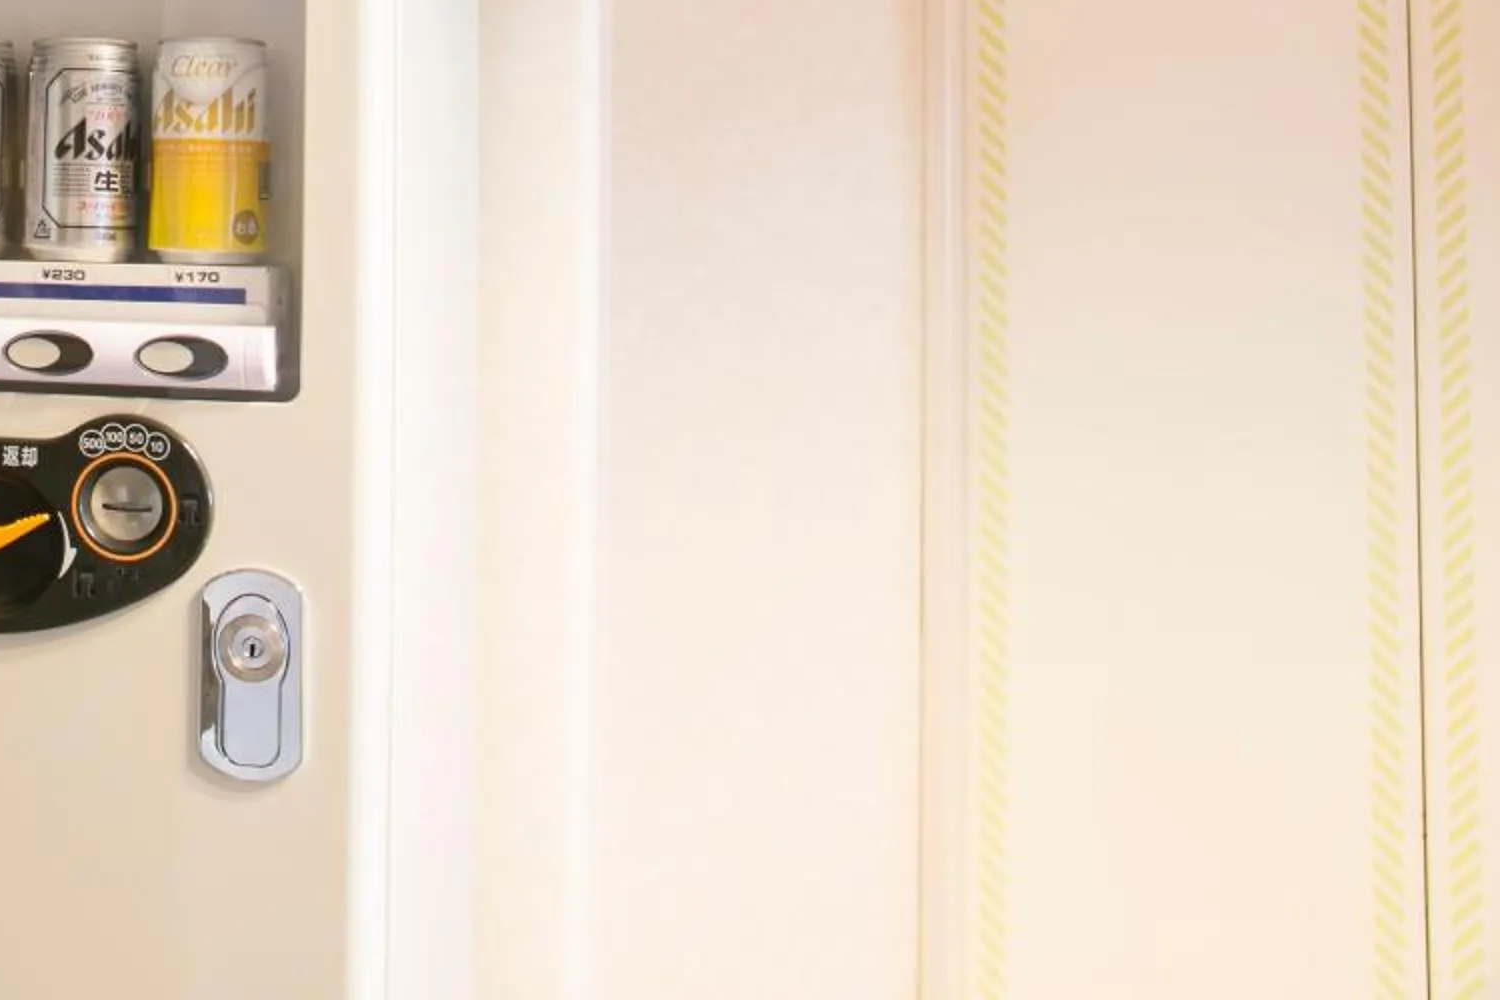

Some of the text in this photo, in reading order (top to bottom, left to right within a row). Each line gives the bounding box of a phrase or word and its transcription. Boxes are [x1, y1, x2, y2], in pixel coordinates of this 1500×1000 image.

[170, 54, 239, 78] Clear
[154, 86, 256, 134] Asahi
[54, 116, 138, 161] Asah
[94, 170, 119, 192] 生
[41, 269, 85, 281] ¥230
[175, 271, 220, 283] ¥170
[83, 431, 165, 453] 500 100 50 10
